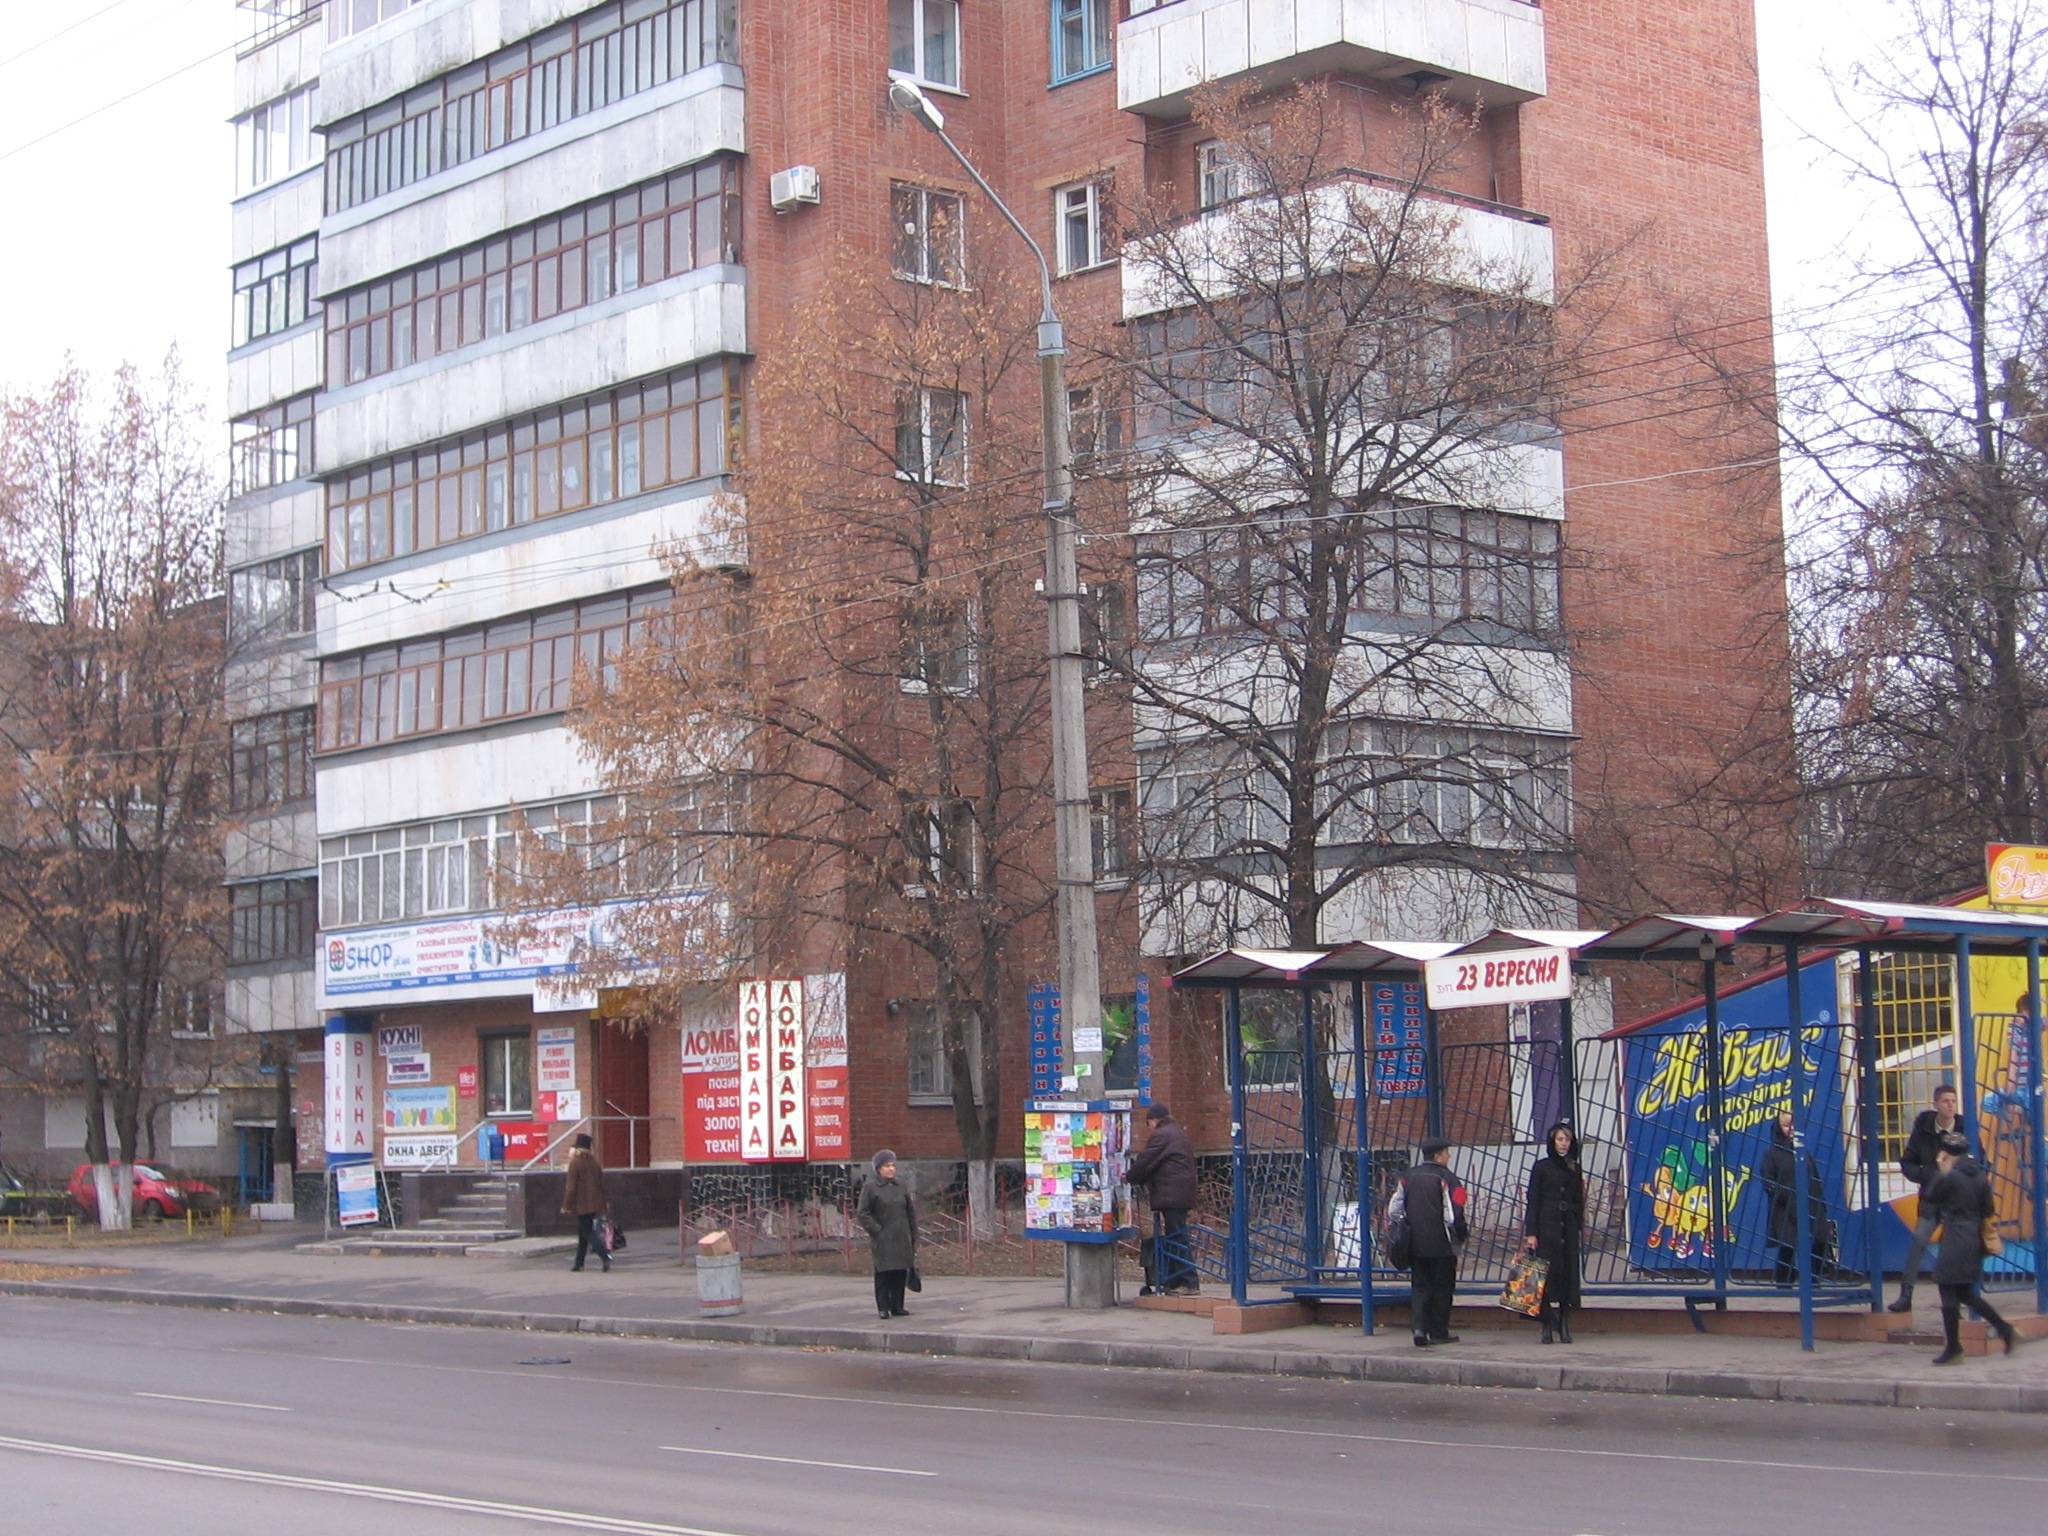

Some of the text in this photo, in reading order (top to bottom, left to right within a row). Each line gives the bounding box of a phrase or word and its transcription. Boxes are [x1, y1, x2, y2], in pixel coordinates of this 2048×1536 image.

[346, 943, 392, 970] SHOP
[1456, 964, 1478, 991] 23
[1484, 955, 1559, 988] ВЕРЕСНЯ
[380, 1027, 420, 1046] КУХНІ
[684, 1028, 738, 1056] ЛОМБ
[1377, 983, 1396, 1075] СТІЙНЕ
[334, 1041, 342, 1145] ВІКНА
[354, 1041, 364, 1145] ВІКНА
[746, 984, 762, 1148] ЛОМБАРД
[778, 984, 797, 1147] ЛОМБАРД
[697, 1094, 715, 1110] під
